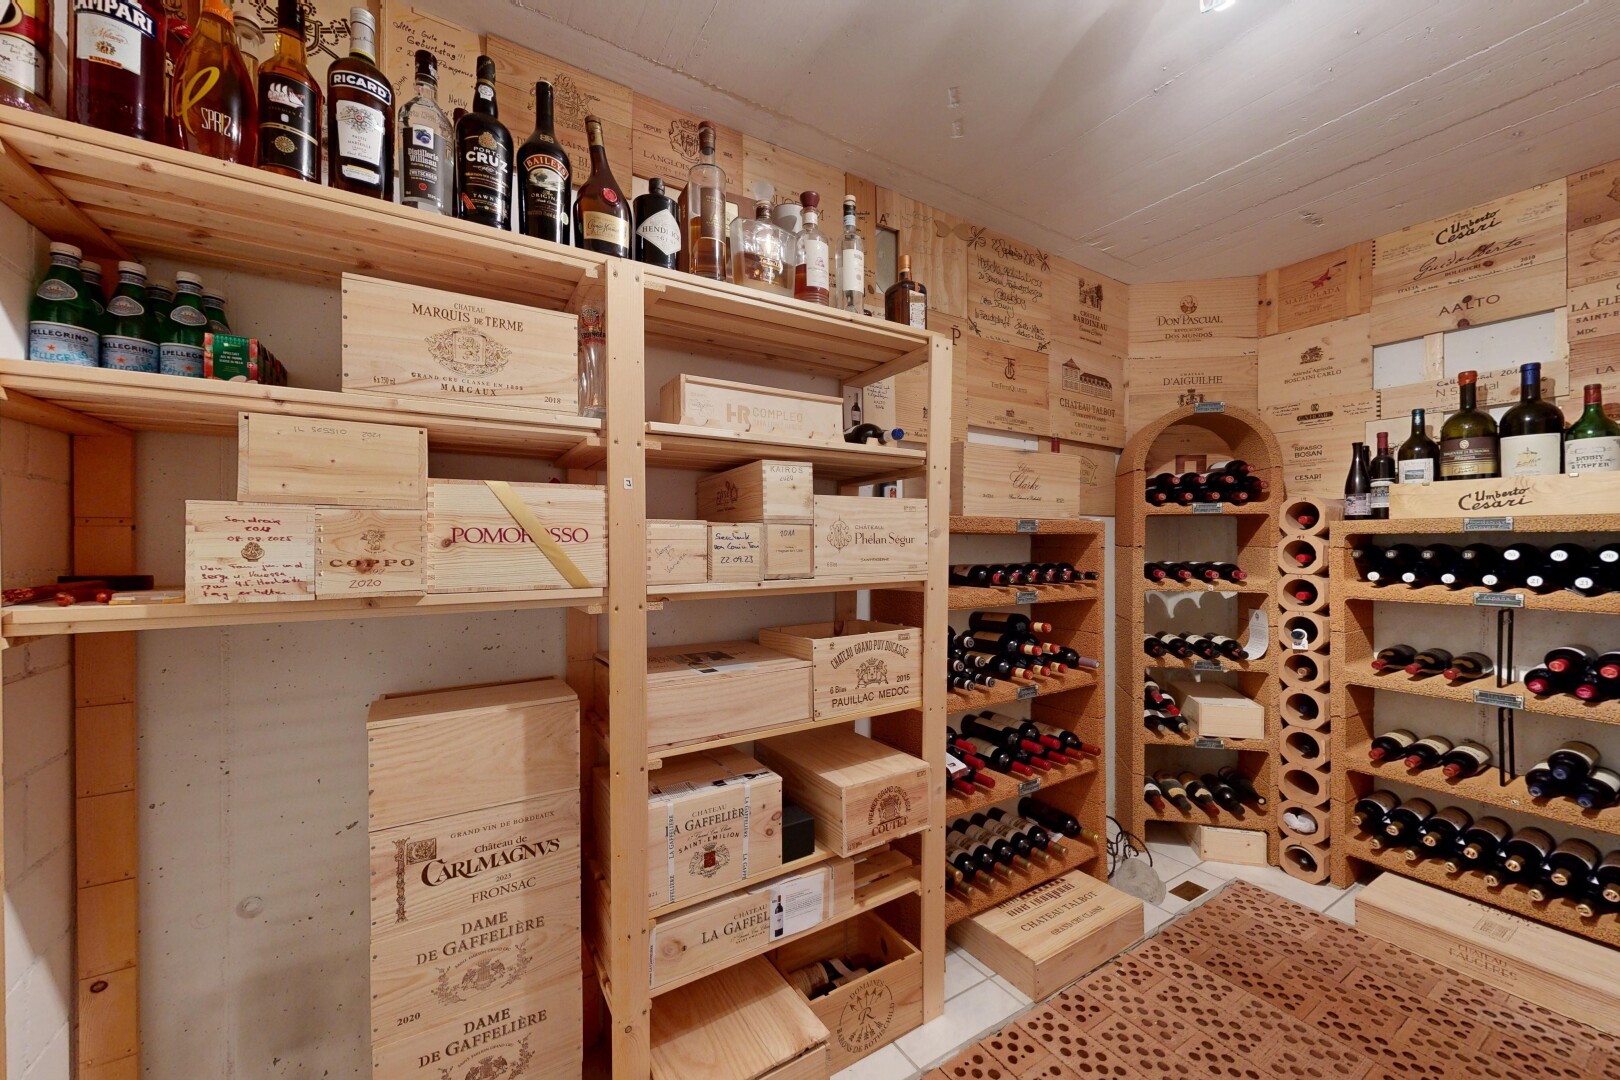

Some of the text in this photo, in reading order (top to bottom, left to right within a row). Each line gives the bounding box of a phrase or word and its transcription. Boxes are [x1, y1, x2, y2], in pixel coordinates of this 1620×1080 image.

[333, 73, 388, 99] RICARD
[473, 146, 501, 159] PORTO
[465, 150, 509, 173] CRUZ
[526, 156, 568, 178] BAILEYS
[1450, 208, 1501, 233] Umberto
[1435, 217, 1503, 246] Cesari
[1444, 264, 1481, 277] BOLGHERI
[453, 302, 486, 314] CHATEAU
[1438, 294, 1501, 317] AALTO
[1571, 302, 1590, 312] LA
[411, 302, 471, 323] MARQUIS
[485, 316, 524, 333] TERME
[1073, 314, 1108, 332] BARDINEAU
[1156, 313, 1223, 327] DON PASCUAL
[1181, 331, 1213, 339] MUNDOS
[1576, 327, 1598, 336] MDC
[411, 372, 439, 381] GRAND
[1284, 369, 1342, 385] BOSCAINI CARLO
[1595, 366, 1615, 375] LA
[1163, 375, 1223, 386] D'AIGUILHE
[440, 383, 497, 397] MARGAUX
[544, 396, 561, 405] 2018
[1059, 397, 1091, 412] CHATEAU
[1091, 404, 1116, 418] TALBOT
[1294, 444, 1323, 452] RIPASSO
[1294, 450, 1323, 459] BOSAN
[769, 466, 804, 474] KAIROS
[1458, 493, 1533, 511] Cesari
[1474, 487, 1530, 502] Umberto
[451, 527, 589, 543] POMORSSO
[854, 531, 915, 547] Phélan Ségur
[328, 558, 415, 568] COPPO
[348, 578, 382, 589] 2020
[830, 639, 910, 670] CHATEAU GRAND PUY DUCASSE
[896, 673, 911, 683] 2015
[831, 685, 910, 708] PAUILLAC MEDOC
[450, 810, 555, 839] GRAND VIN DE BORDEAUX
[684, 807, 751, 833] GAFFELIÈR
[871, 816, 909, 837] COUTET
[474, 835, 528, 854] Château de
[421, 838, 560, 887] CARLMAGNVS
[471, 877, 537, 903] FRONSAC
[1020, 890, 1098, 932] CHATEAU TALBOT
[461, 911, 509, 936] DAME
[701, 912, 770, 944] LA GAFFEL
[1050, 920, 1073, 936] GRAND
[416, 915, 546, 966] DE GAFFELIÈRE
[396, 1012, 421, 1027] 2020
[463, 1007, 511, 1036] DAME
[418, 1009, 548, 1069] DE GAFFELIÈRE
